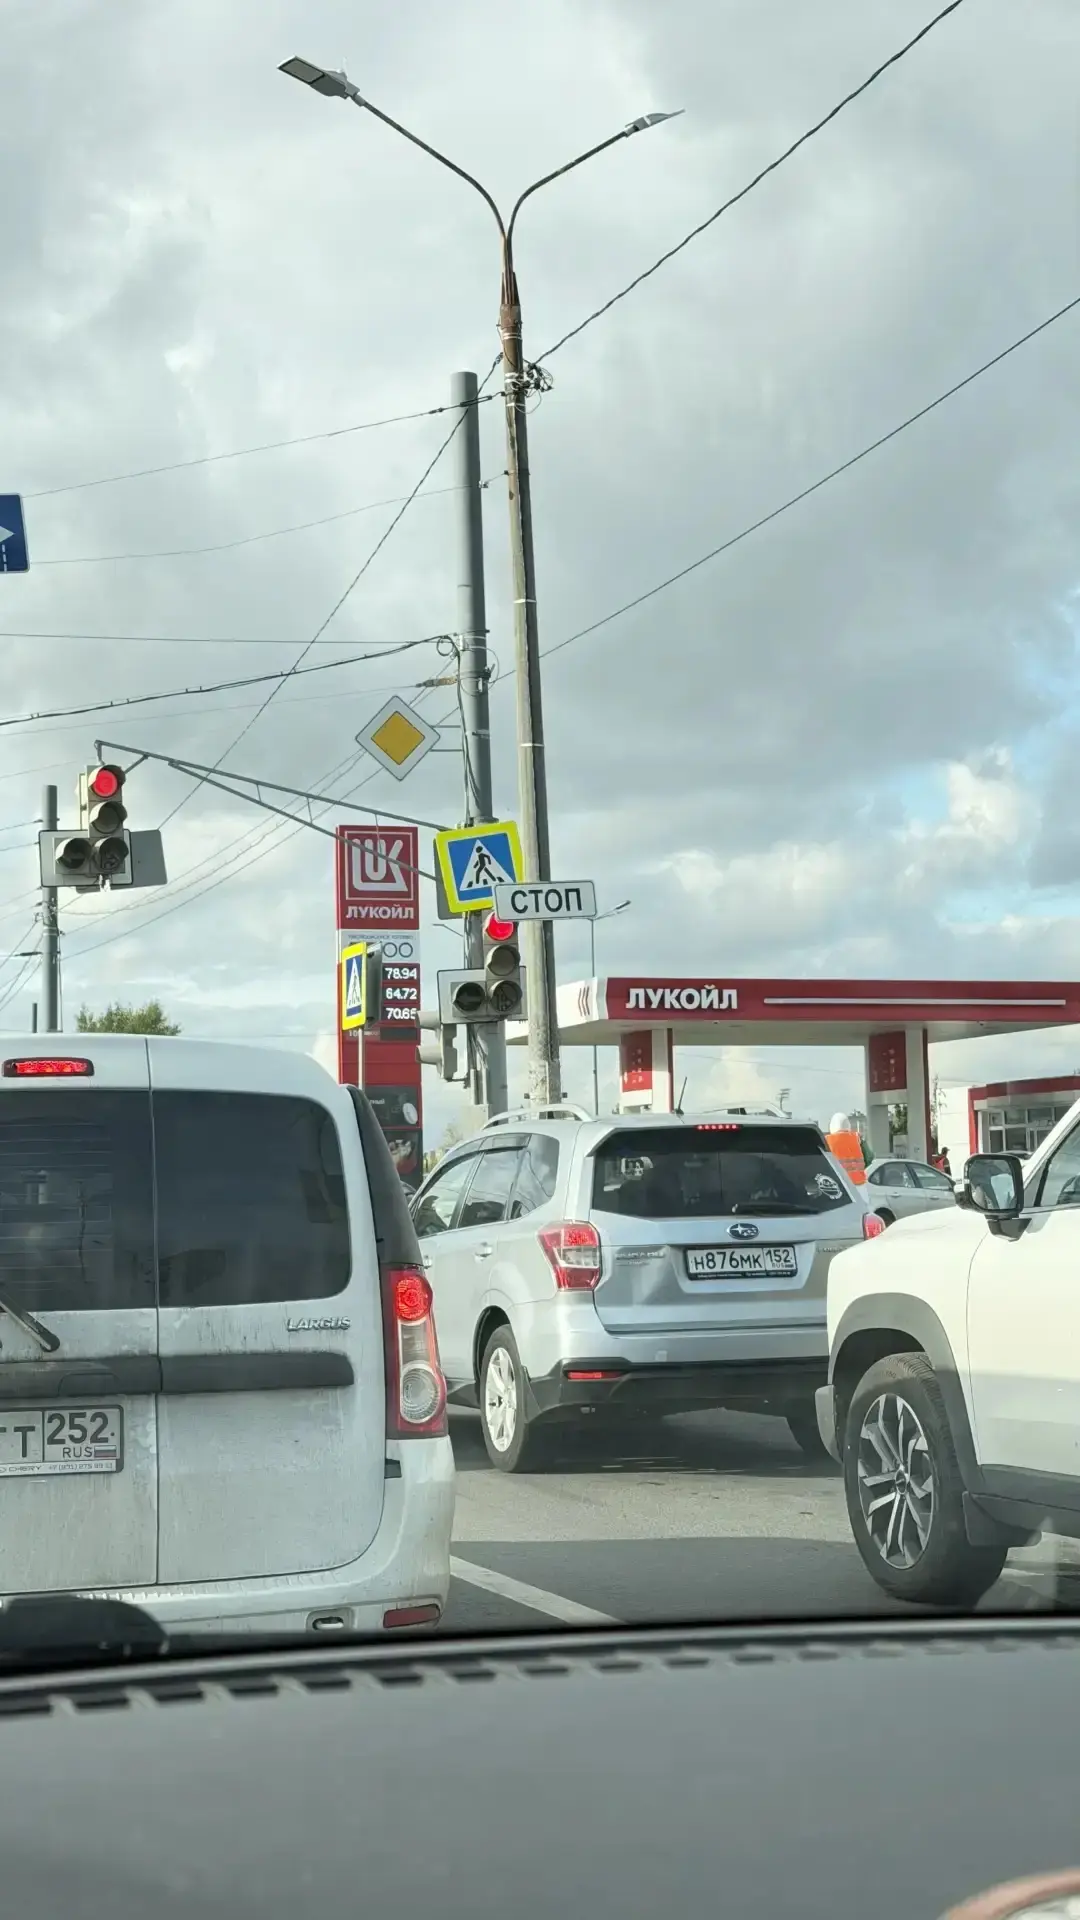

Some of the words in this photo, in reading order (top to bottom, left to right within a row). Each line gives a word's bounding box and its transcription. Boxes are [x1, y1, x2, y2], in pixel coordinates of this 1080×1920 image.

[511, 888, 582, 914] СТОП
[345, 903, 414, 919] ЛУКОЙЛ
[385, 967, 417, 980] 78.94
[385, 987, 417, 999] 64.72
[626, 984, 738, 1009] ЛУКОЙЛ
[694, 1251, 763, 1270] Н876МК
[766, 1248, 791, 1263] 152
[287, 1316, 351, 1332] LARGUS
[46, 1411, 109, 1445] 252
[62, 1446, 93, 1458] RUS
